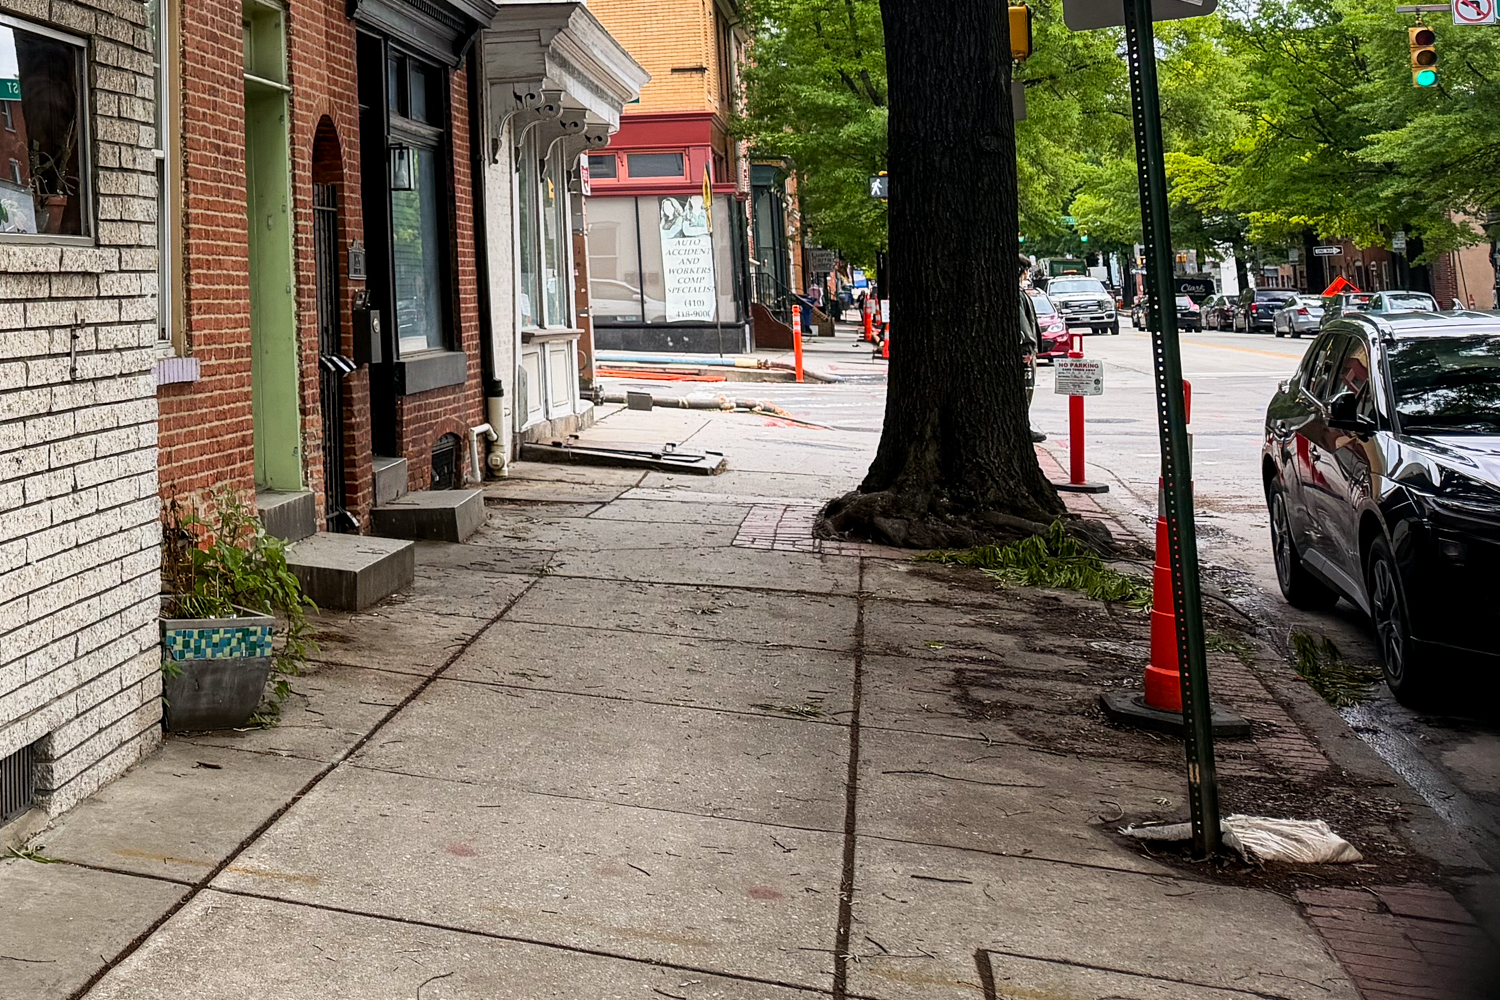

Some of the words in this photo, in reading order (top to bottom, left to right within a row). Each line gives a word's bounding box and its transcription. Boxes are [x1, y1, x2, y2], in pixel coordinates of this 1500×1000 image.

[678, 257, 700, 265] AND
[668, 266, 712, 275] WORKERS
[677, 276, 705, 284] COMP
[1180, 283, 1206, 293] Clark
